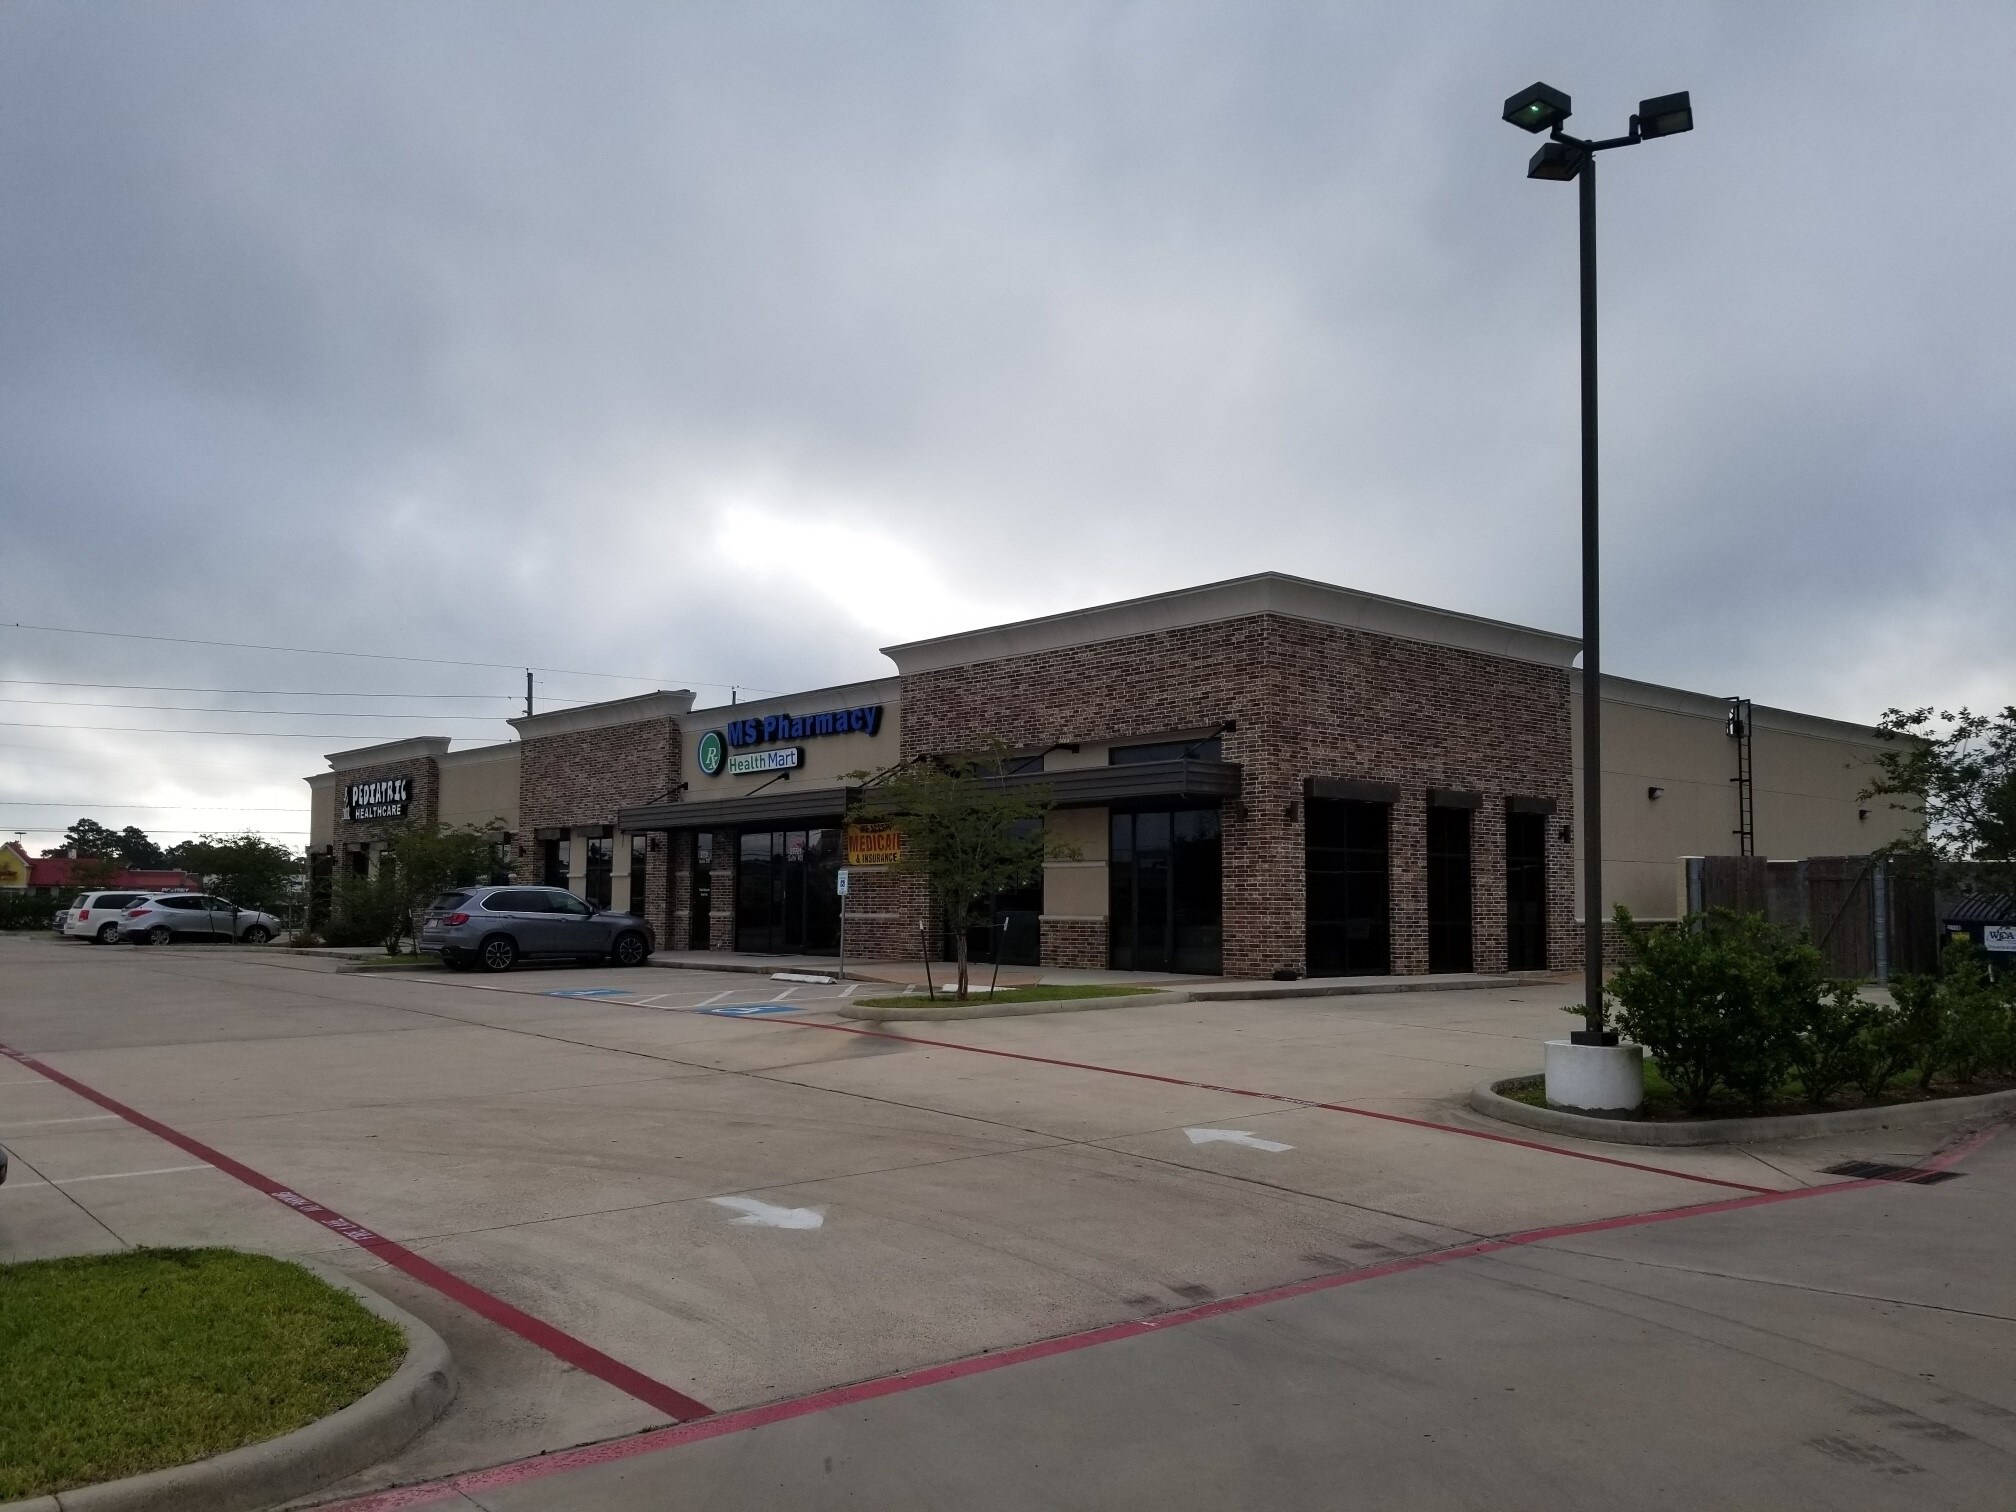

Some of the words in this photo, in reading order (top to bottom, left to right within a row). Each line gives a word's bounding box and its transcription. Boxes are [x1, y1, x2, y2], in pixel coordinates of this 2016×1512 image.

[728, 718, 758, 746] MS
[764, 706, 878, 742] Pharmacy
[729, 754, 766, 772] Health
[768, 750, 796, 767] Mart
[352, 779, 407, 807] PEDIATRIC
[355, 804, 401, 820] HEALTHCARE
[862, 853, 897, 863] INSURANCE
